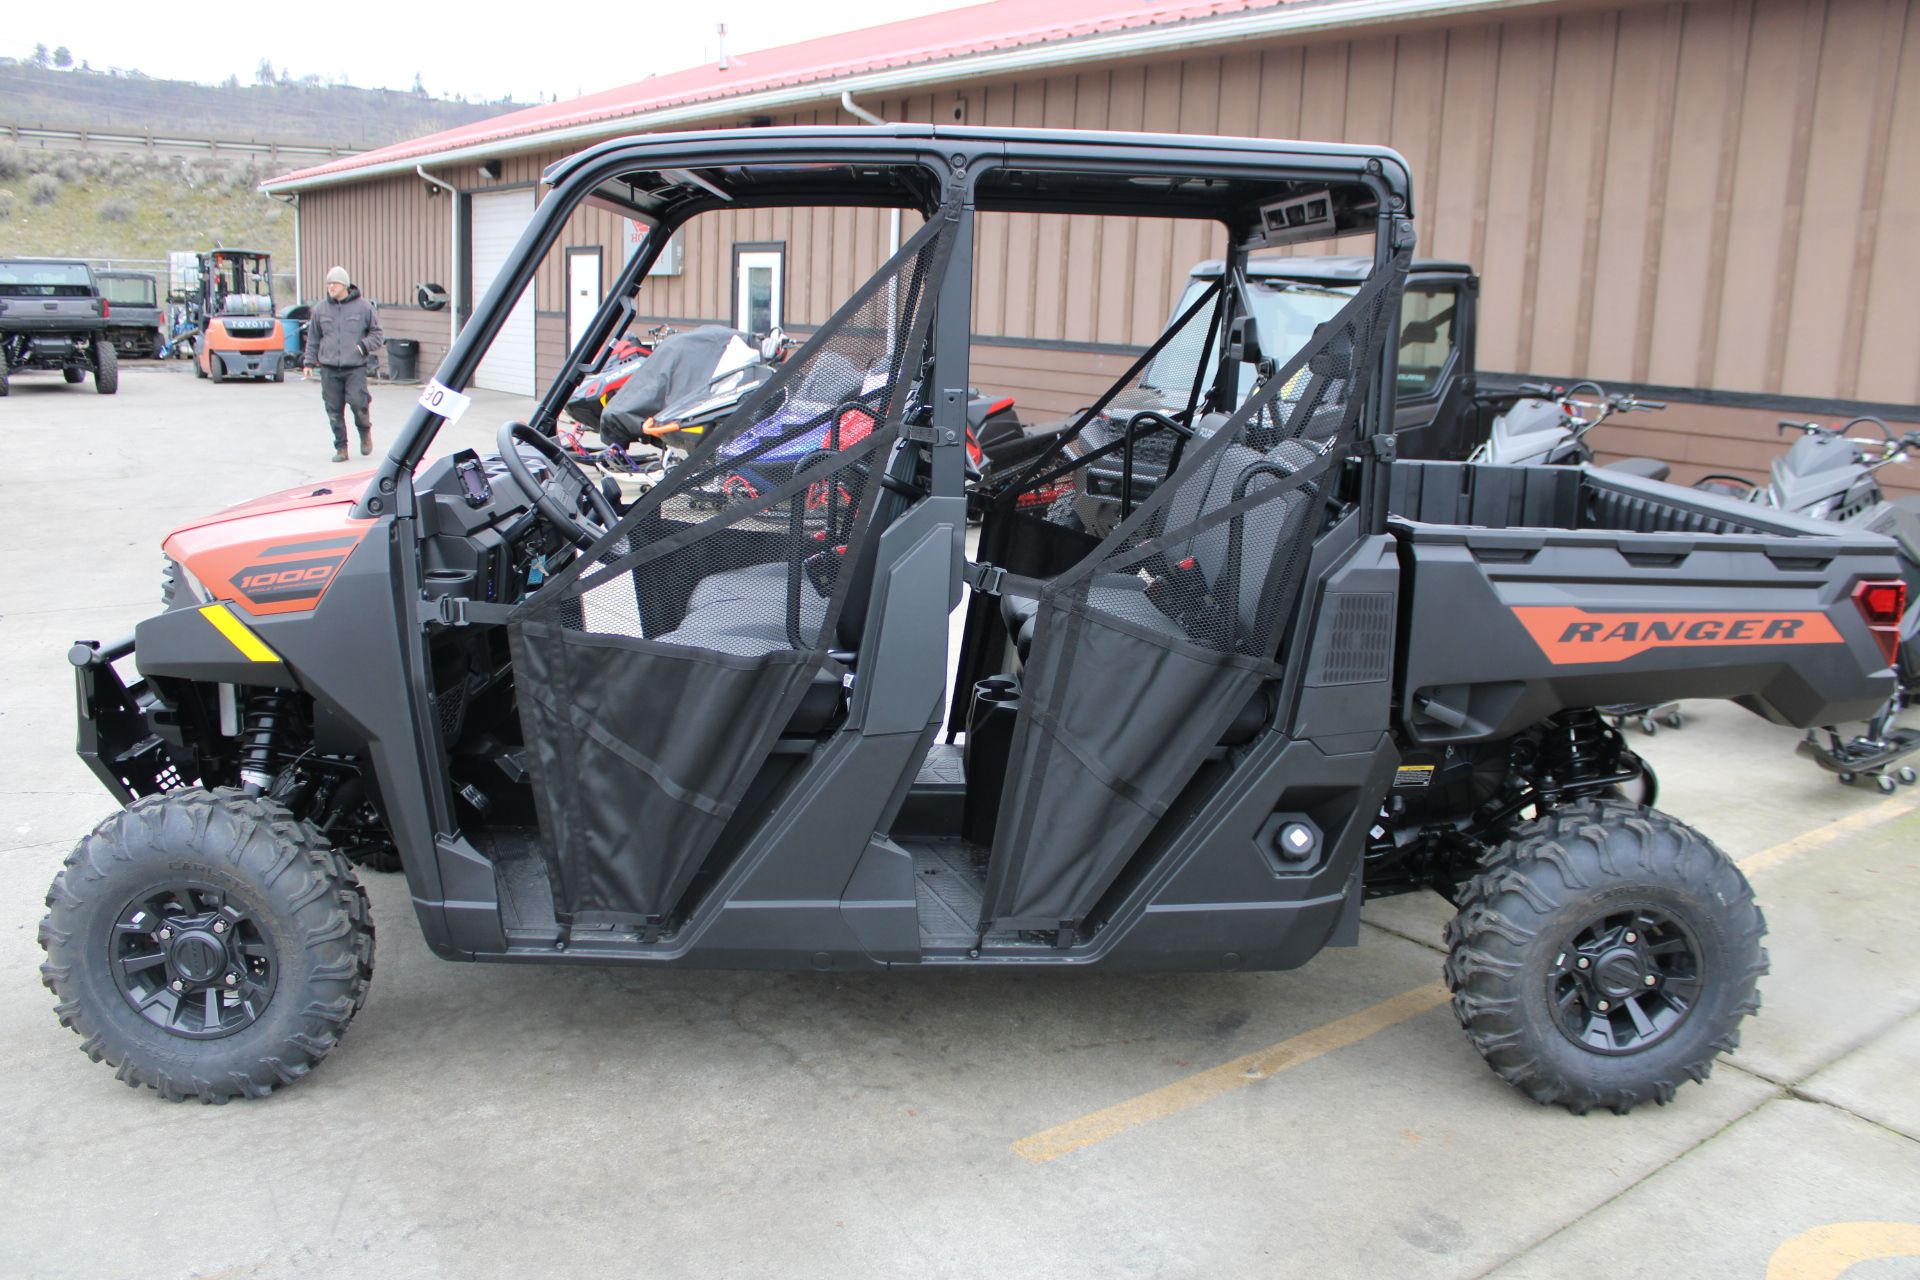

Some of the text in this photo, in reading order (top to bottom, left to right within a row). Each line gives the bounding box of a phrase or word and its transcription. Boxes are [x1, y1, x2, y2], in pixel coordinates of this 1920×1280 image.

[231, 320, 271, 329] TOYOTA
[240, 565, 333, 589] 1000
[1557, 619, 1804, 643] RANGER
